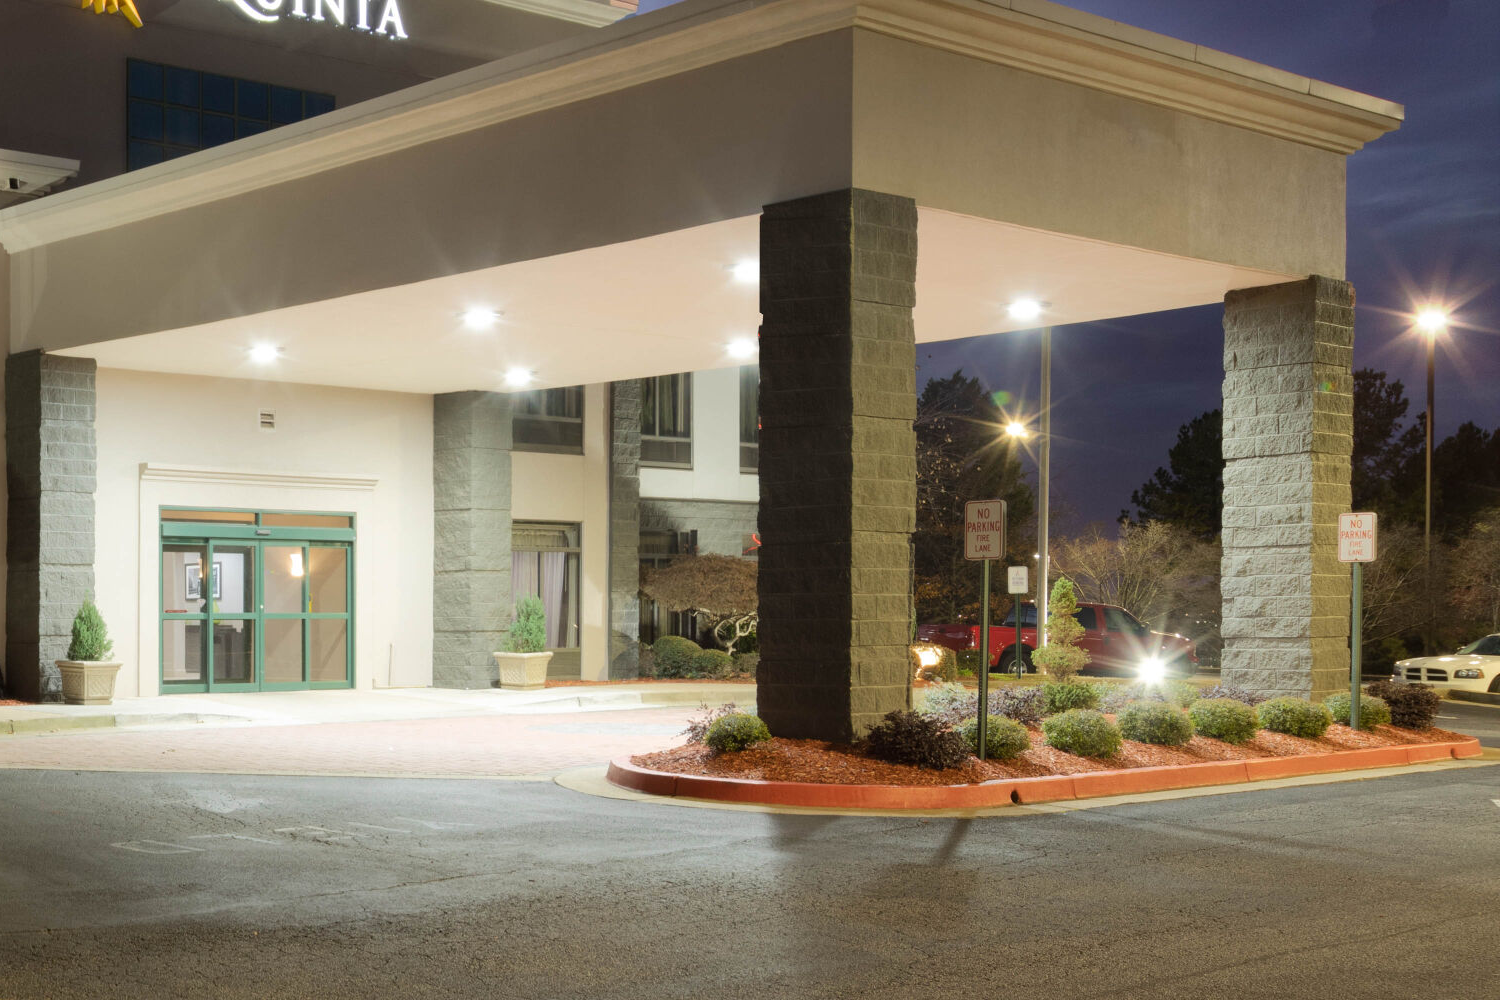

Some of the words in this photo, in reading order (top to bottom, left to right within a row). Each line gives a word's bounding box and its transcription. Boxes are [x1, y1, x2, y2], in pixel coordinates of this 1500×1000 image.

[977, 508, 990, 519] NO
[967, 521, 1000, 533] PARKING
[1350, 519, 1363, 529] NO
[1341, 530, 1373, 539] PARKING
[975, 544, 991, 552] LANE
